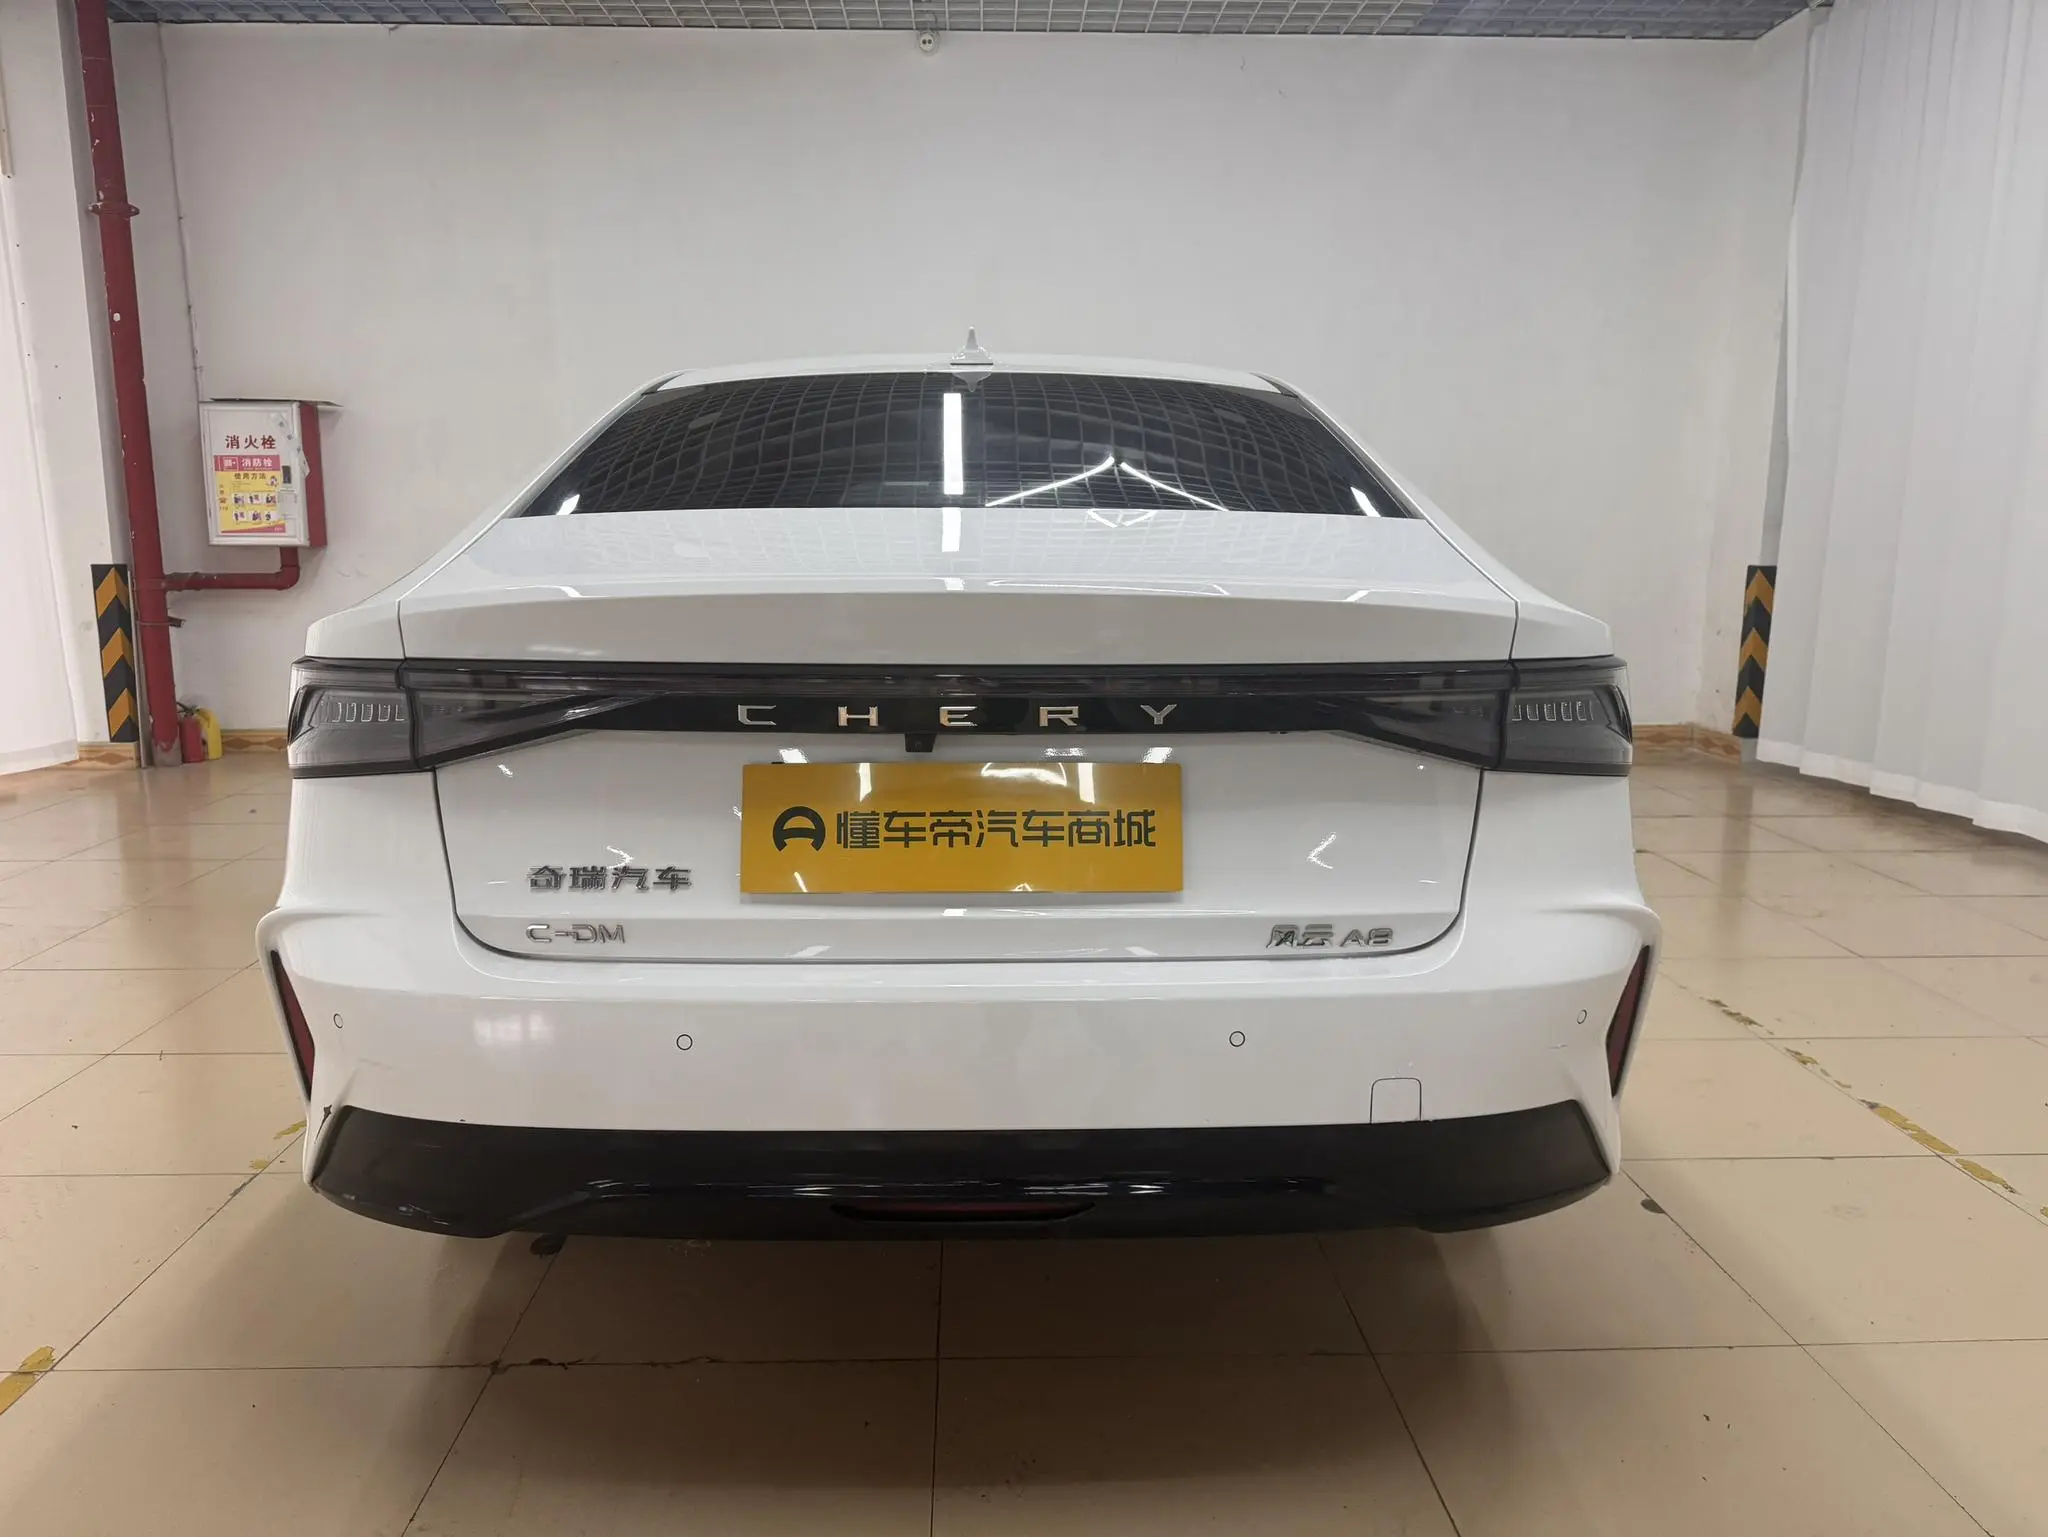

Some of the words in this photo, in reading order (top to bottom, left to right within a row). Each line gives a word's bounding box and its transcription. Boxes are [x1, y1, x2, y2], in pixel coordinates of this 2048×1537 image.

[225, 435, 276, 449] 消火栓
[737, 704, 1177, 726] CHERY
[836, 809, 1156, 848] 懂车帝汽车商城
[528, 866, 692, 890] 奇瑞汽车
[526, 924, 626, 944] C-DM
[1266, 924, 1333, 948] 风云
[1340, 928, 1393, 947] A8
